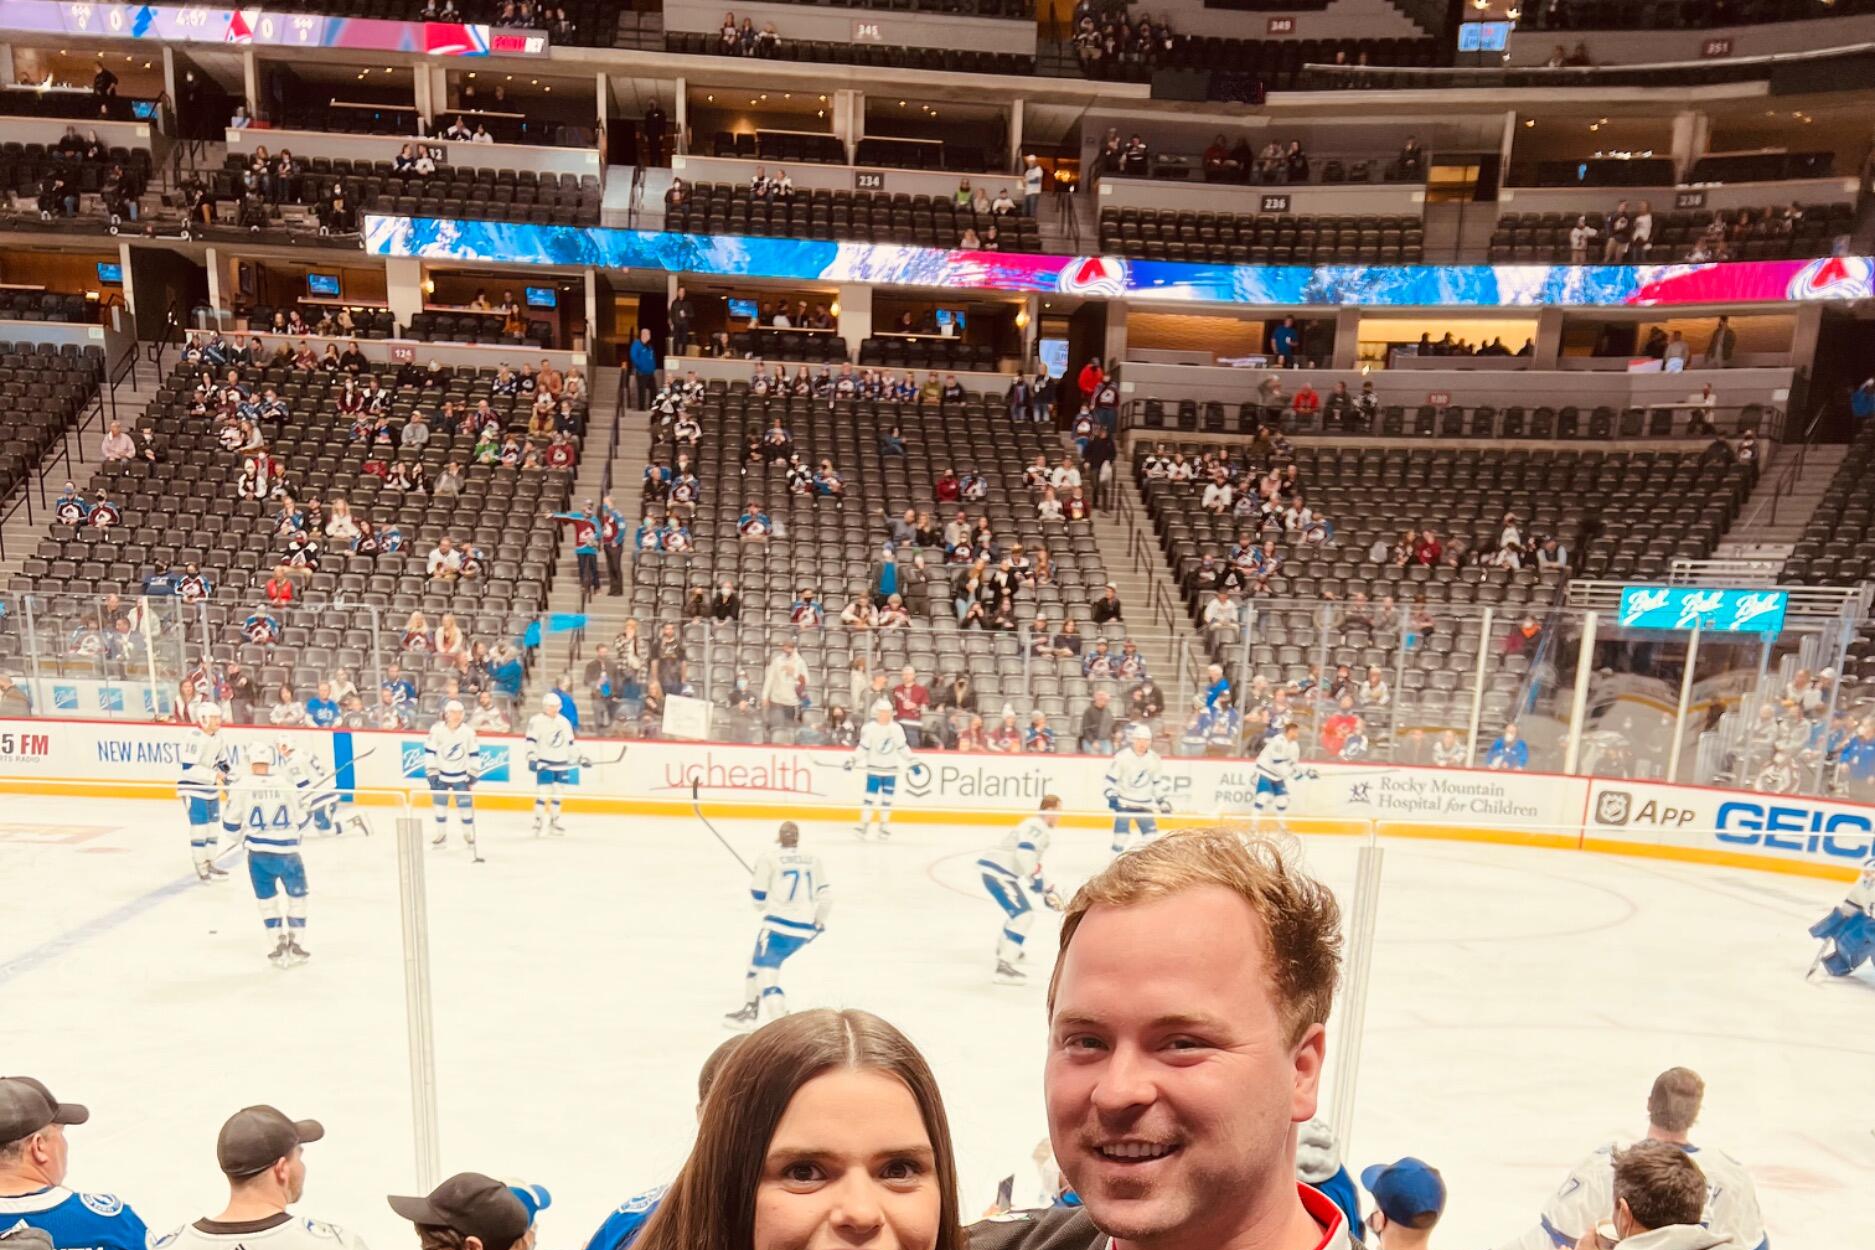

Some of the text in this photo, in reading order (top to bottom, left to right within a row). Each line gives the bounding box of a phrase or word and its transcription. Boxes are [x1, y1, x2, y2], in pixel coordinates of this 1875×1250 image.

[859, 175, 880, 187] 234
[1264, 199, 1286, 209] 236
[20, 734, 49, 756] FM
[97, 741, 131, 762] NEW
[665, 752, 812, 794] uchealth
[940, 766, 1053, 798] Palantir
[1380, 776, 1505, 796] Rocky Mountain
[1378, 794, 1538, 817] Hospital for Children
[249, 805, 291, 830] 44
[1714, 801, 1875, 859] GEIC
[783, 870, 813, 902] 71
